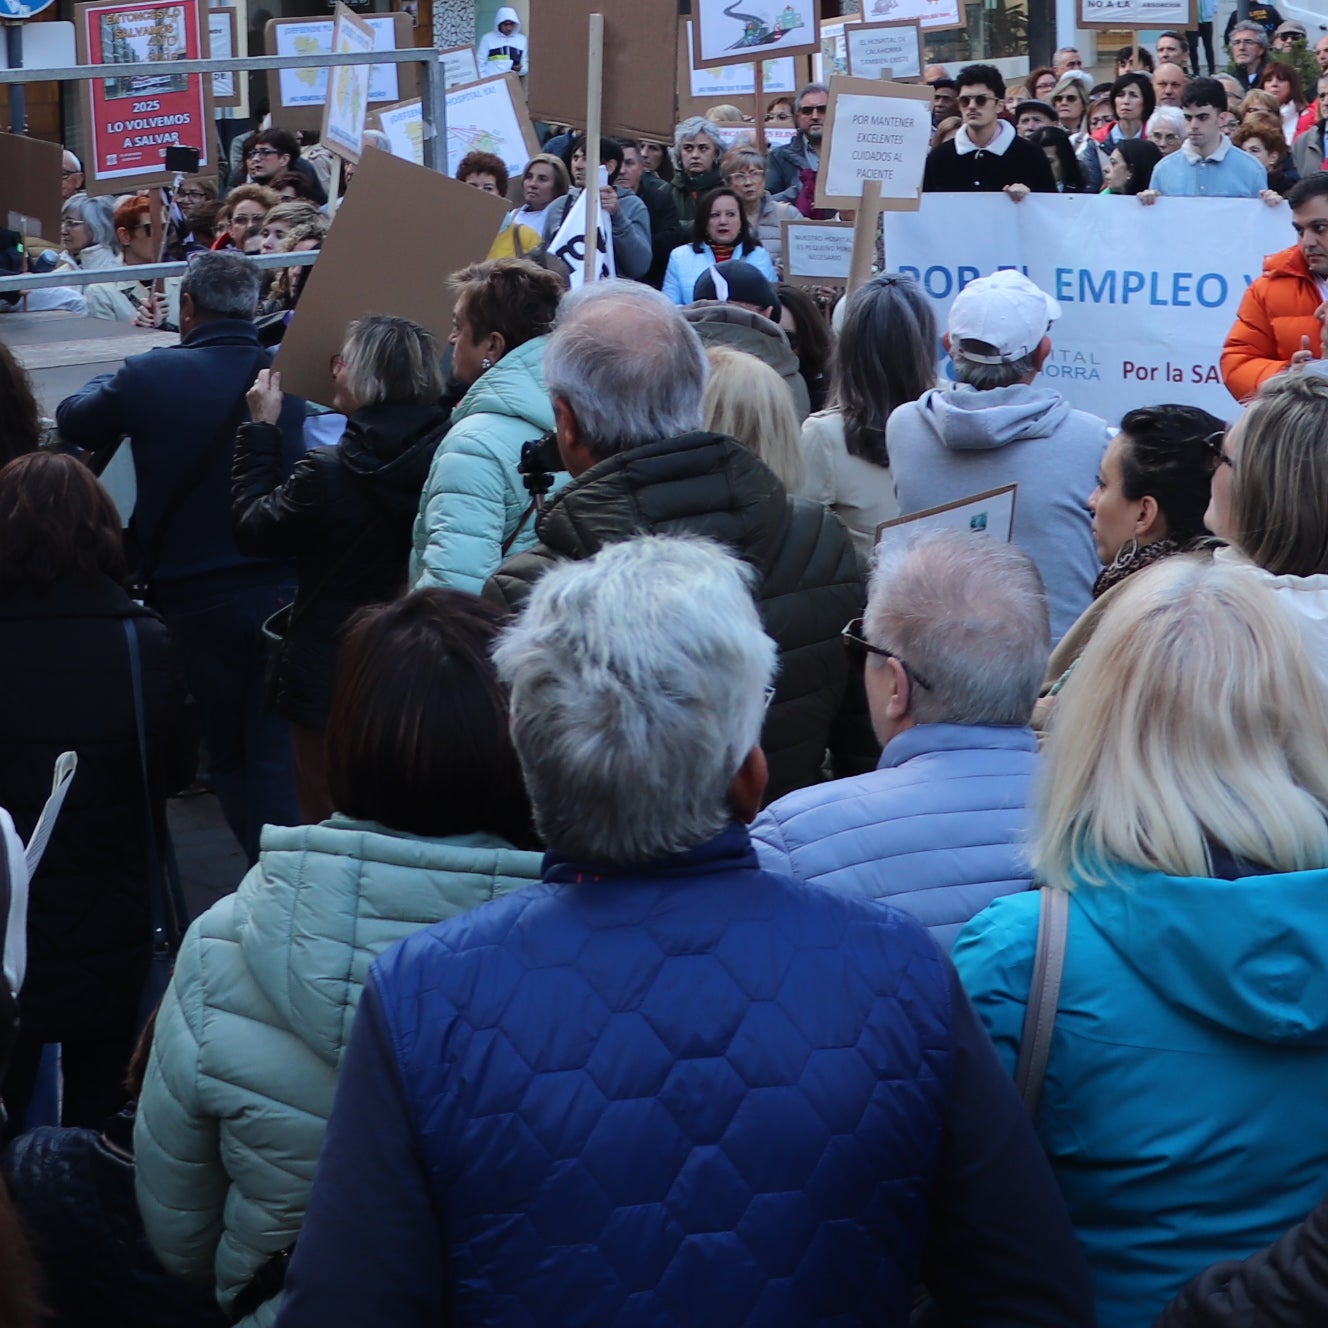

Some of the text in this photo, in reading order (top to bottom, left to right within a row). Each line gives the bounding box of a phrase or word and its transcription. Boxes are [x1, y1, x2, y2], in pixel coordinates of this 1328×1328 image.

[1088, 0, 1103, 8] NO
[1106, 0, 1114, 8] A
[1117, 0, 1130, 8] LA
[106, 10, 163, 24] ENTONCES
[113, 24, 174, 40] SALVAMOS
[132, 100, 160, 113] 2025
[390, 108, 422, 125] ¡DEFIEN
[447, 90, 482, 106] HOSPITAL
[107, 113, 190, 134] LO VOLVEMOS
[852, 115, 914, 128] POR MANTENER
[123, 131, 179, 148] A SALVAR
[857, 133, 904, 145] EXCELENTES
[852, 151, 903, 162] CUIDADOS AL
[856, 169, 894, 180] PACIENTE
[1056, 267, 1228, 308] EMPLEO
[1050, 349, 1102, 365] ITAL
[1121, 360, 1223, 385] Por la SA
